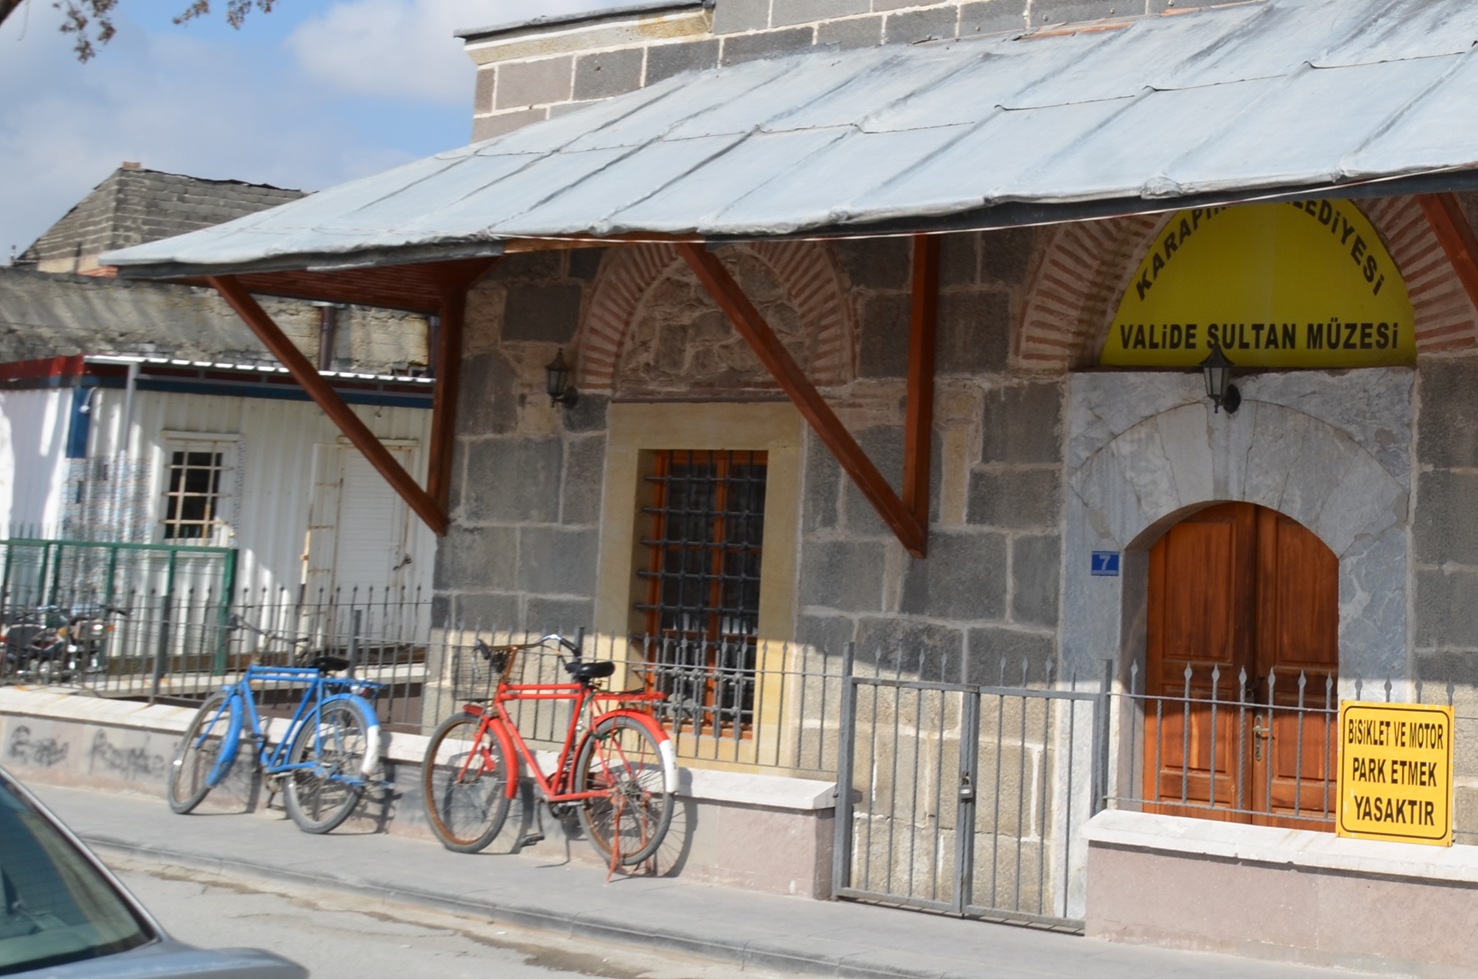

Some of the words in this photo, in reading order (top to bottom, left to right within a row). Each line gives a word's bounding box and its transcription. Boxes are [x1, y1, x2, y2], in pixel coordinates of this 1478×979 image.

[1206, 323, 1297, 350] SULTAN
[1099, 554, 1111, 571] 7
[1393, 721, 1406, 748] VE
[1409, 722, 1444, 750] MOTOR
[1352, 757, 1387, 784] PARK
[1390, 759, 1437, 788] ETMEK
[1354, 795, 1435, 827] YASAKTIR
